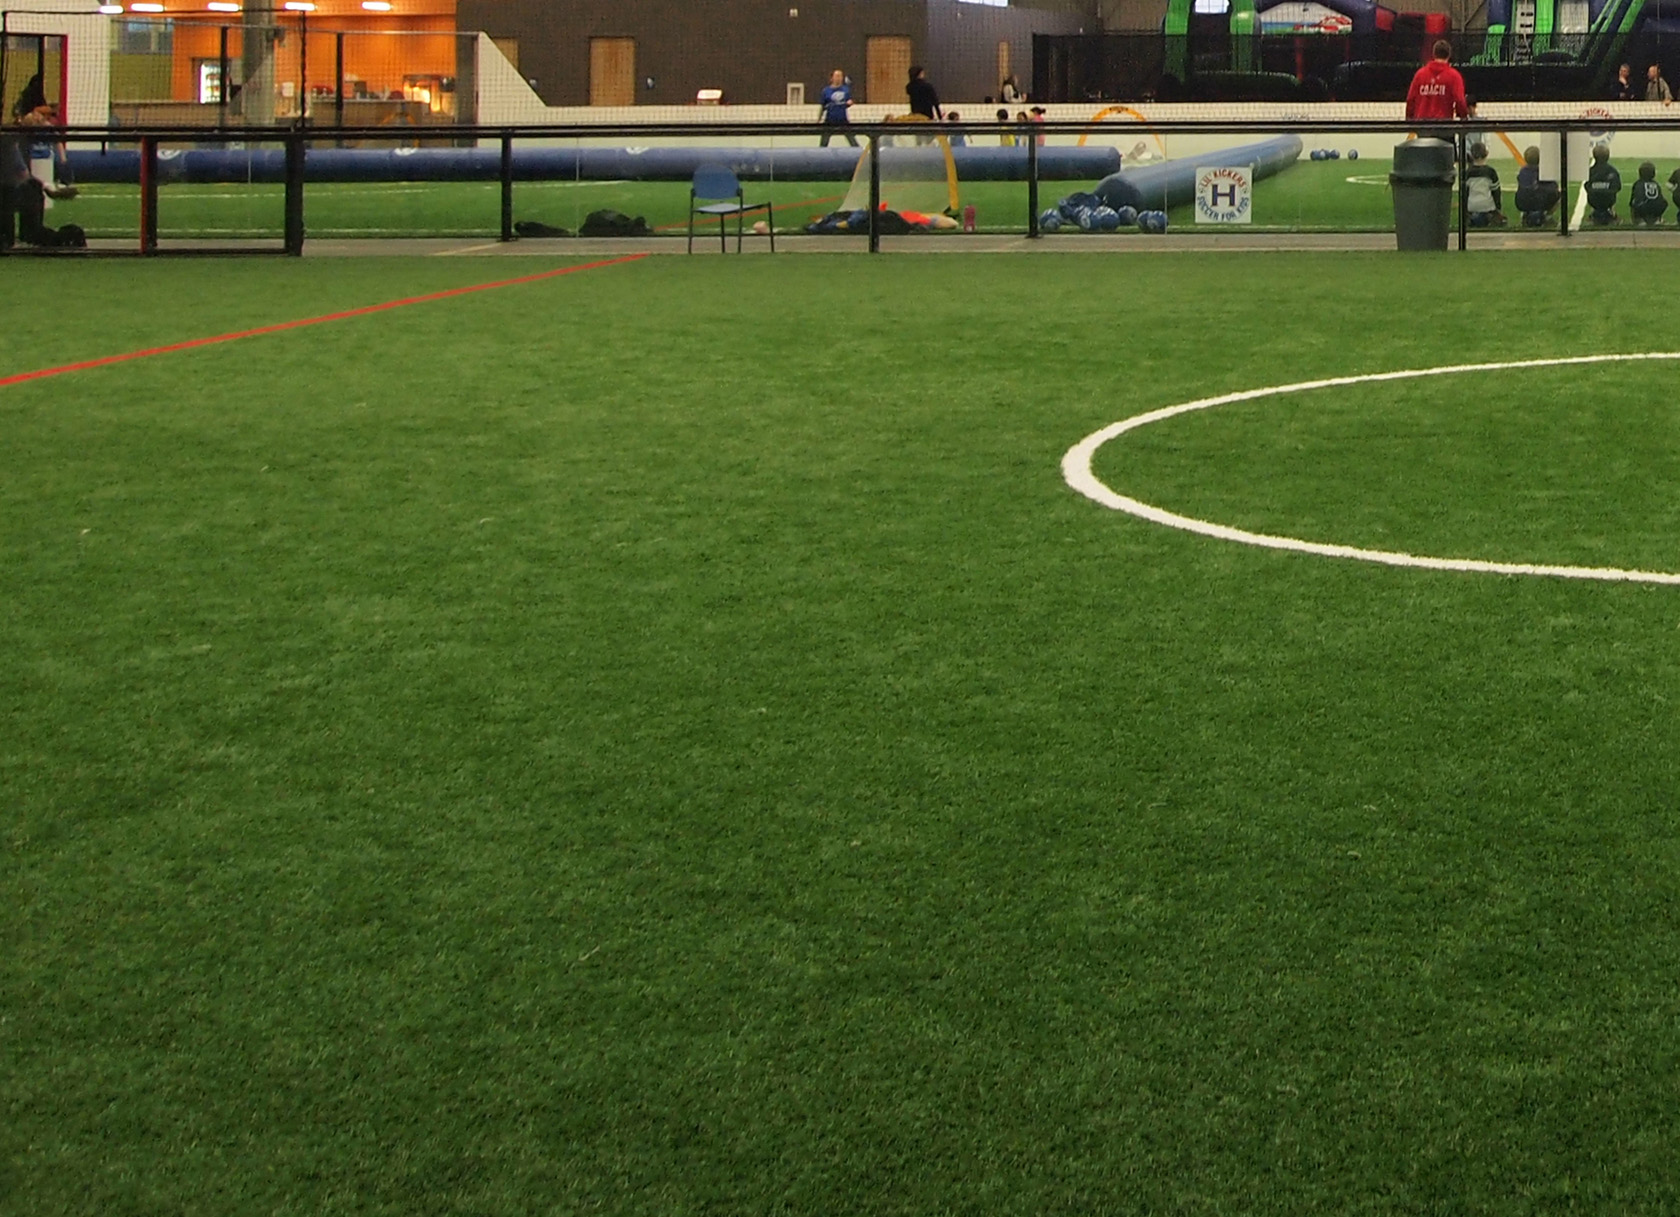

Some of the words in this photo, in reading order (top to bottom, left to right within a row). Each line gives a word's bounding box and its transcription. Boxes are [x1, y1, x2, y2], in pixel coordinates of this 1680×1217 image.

[1420, 84, 1446, 96] COACH
[1213, 168, 1246, 187] KICKERS
[1211, 184, 1236, 206] H
[1197, 195, 1219, 220] SOCCER
[1221, 211, 1237, 221] FOR
[1236, 196, 1249, 214] KIDS
